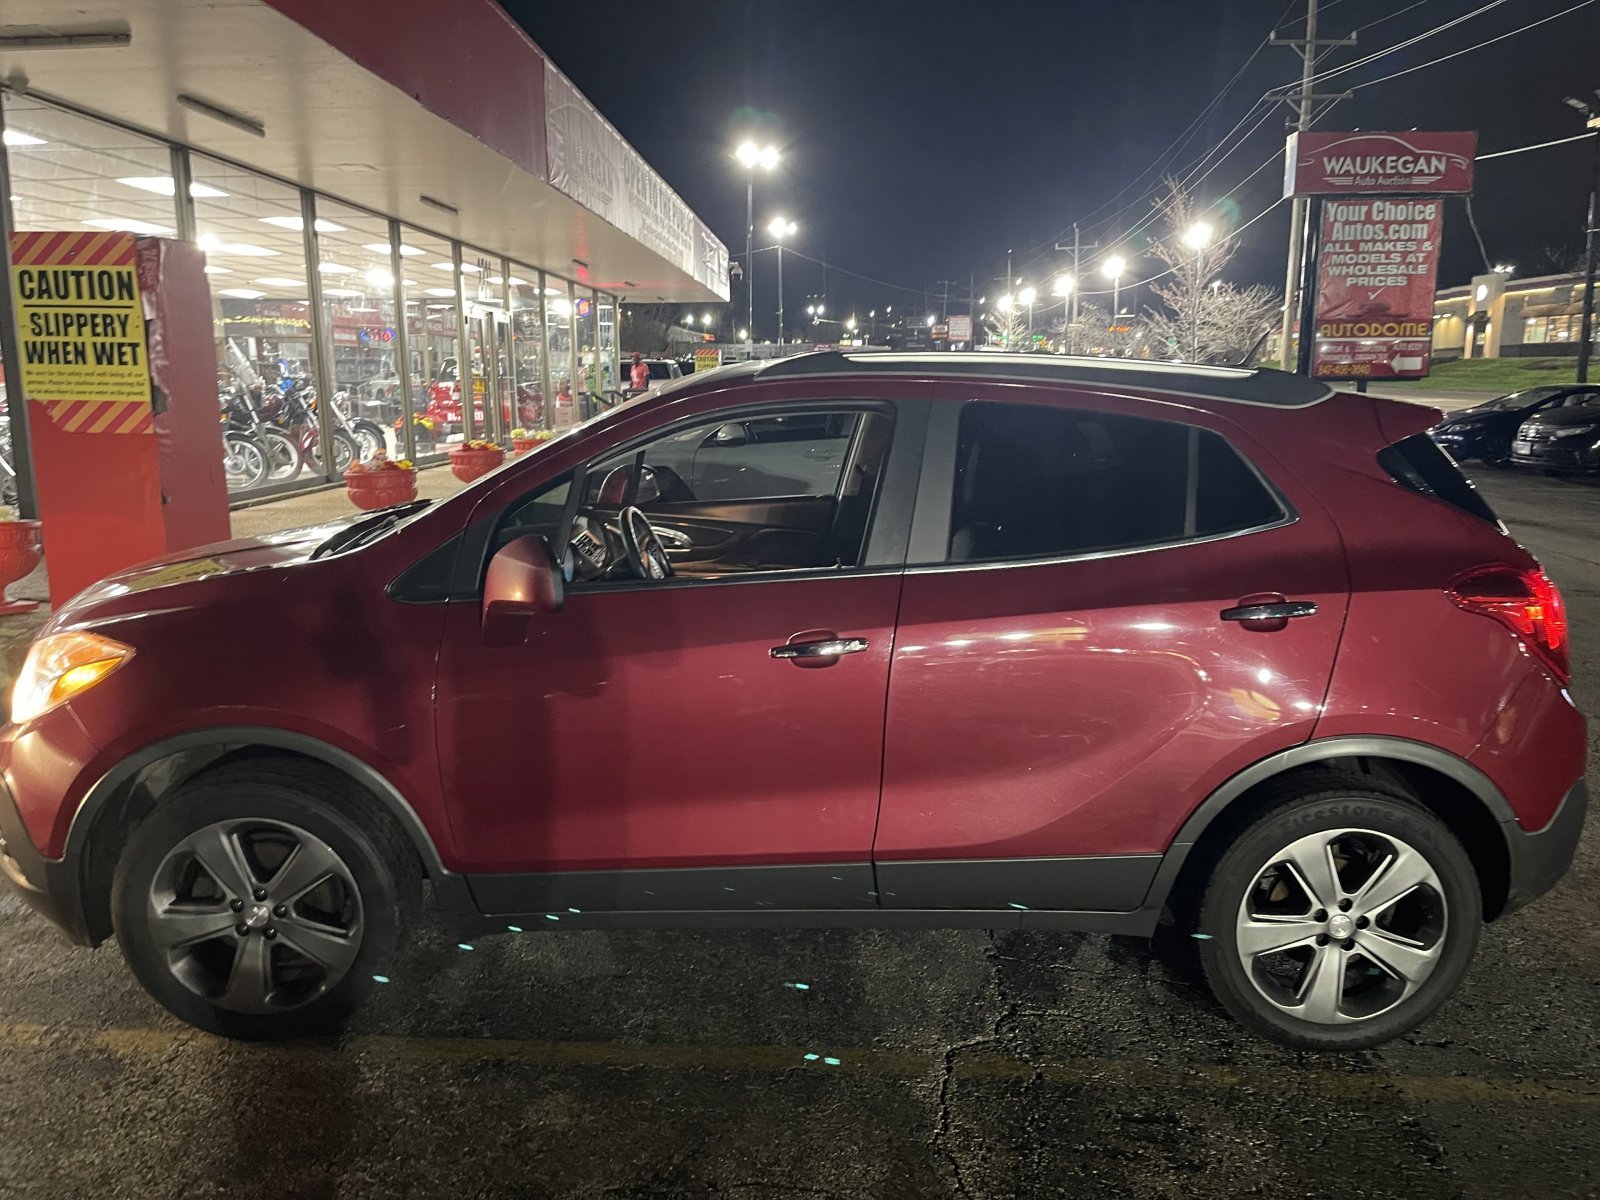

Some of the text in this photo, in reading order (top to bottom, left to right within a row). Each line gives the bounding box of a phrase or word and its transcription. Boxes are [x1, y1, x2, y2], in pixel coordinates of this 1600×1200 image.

[1323, 155, 1446, 174] WAUKEGAN
[1354, 176, 1413, 185] Auto Auction
[1327, 201, 1437, 222] Your Choice
[1332, 222, 1429, 241] Autos.com
[1324, 241, 1434, 253] ALL MAKES &
[1331, 253, 1428, 265] MODELS AT
[1327, 264, 1429, 276] WHOLESALE
[19, 269, 135, 301] CAUTION
[1345, 276, 1409, 287] PRICES
[29, 312, 130, 338] SLIPPERY
[1320, 322, 1429, 337] AUTODOME
[24, 340, 141, 366] WHEN WET
